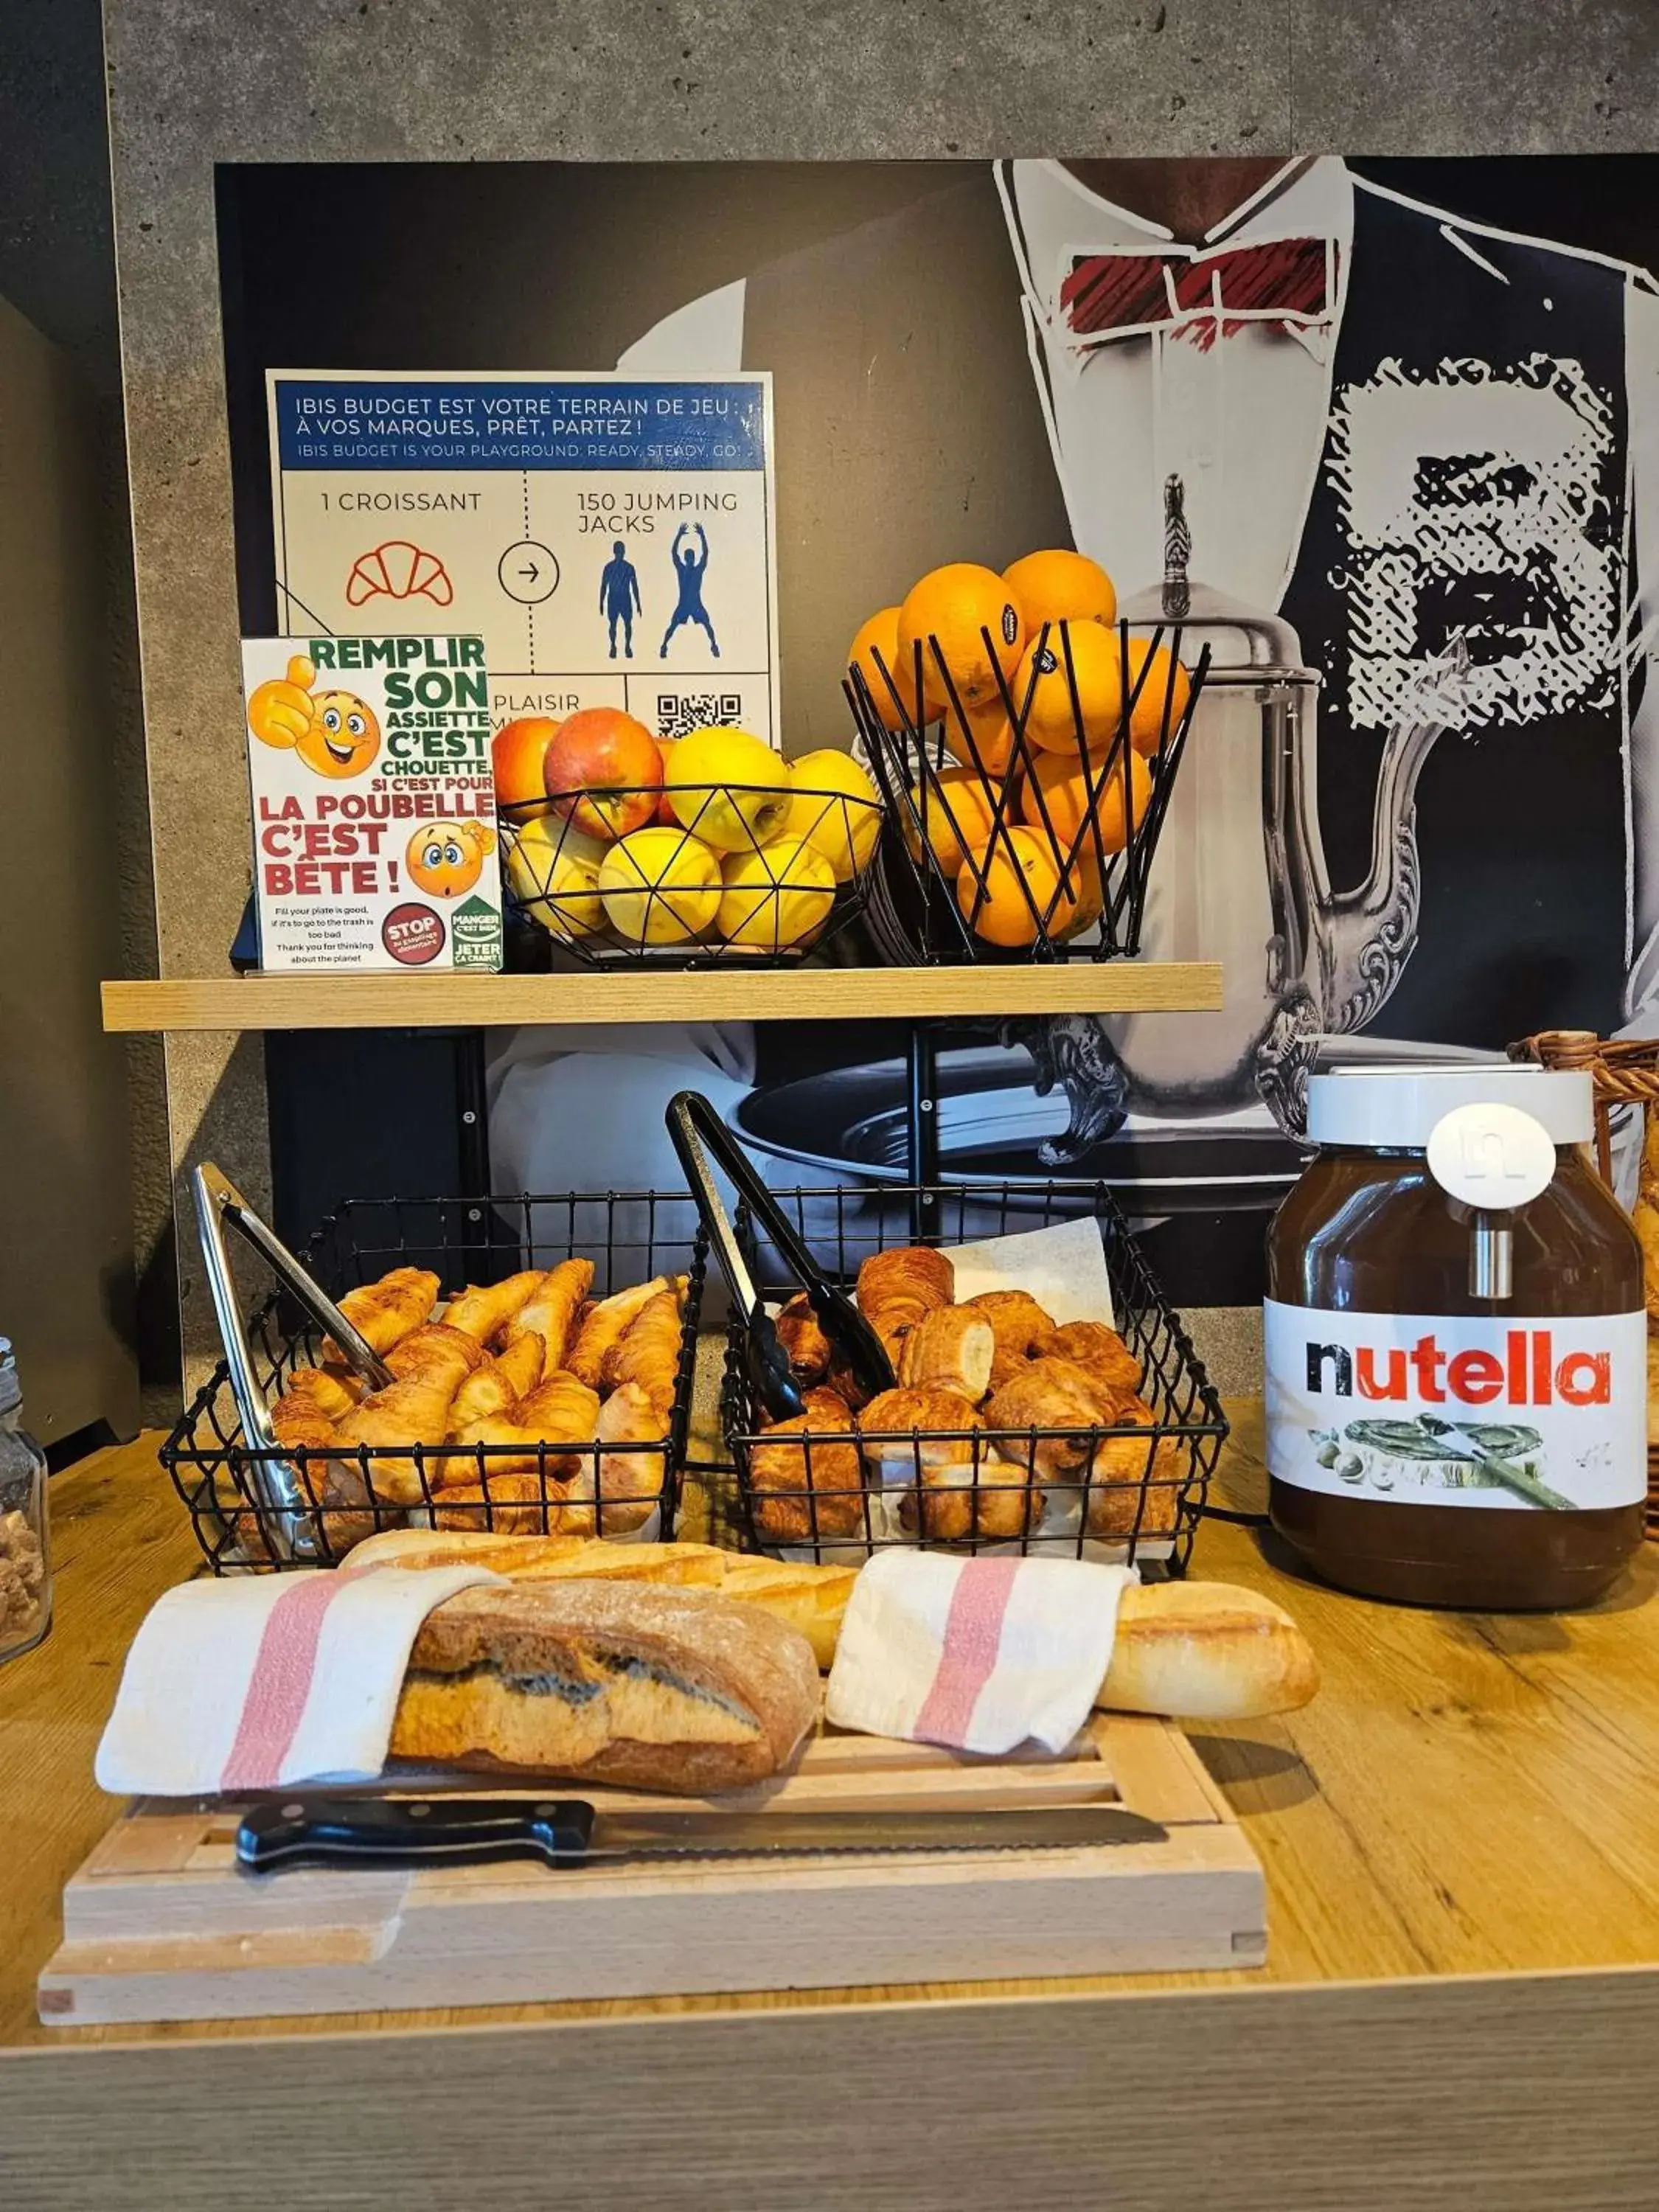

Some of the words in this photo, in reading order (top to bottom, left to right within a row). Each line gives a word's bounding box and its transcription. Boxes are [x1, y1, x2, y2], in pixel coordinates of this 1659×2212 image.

[296, 398, 336, 414] IBIS
[344, 398, 432, 414] BUDGET
[439, 398, 475, 414] EST
[481, 398, 552, 414] VOTRE
[558, 398, 648, 414] TERRAIN
[657, 399, 684, 414] DE
[691, 399, 728, 414] JEU
[296, 416, 311, 434] À
[317, 419, 361, 435] VOS
[369, 419, 480, 437] MARQUES,
[487, 417, 545, 436] PRÊT,
[298, 445, 328, 457] IBIS
[334, 445, 397, 457] BUDGET
[404, 445, 417, 457] IS
[421, 445, 465, 457] YOUR
[588, 445, 643, 458] READY,
[647, 445, 708, 458] STEADY,
[321, 493, 329, 511] 1
[338, 493, 481, 511] CROISSANT
[577, 493, 616, 511] 150
[624, 493, 737, 511] JUMPING
[578, 515, 655, 533] JACKS
[309, 638, 485, 669] REMPLIR
[383, 671, 488, 709] SON
[494, 695, 580, 711] PLAISIR
[386, 711, 490, 728] ASSIETTE
[387, 729, 490, 759] C'EST
[380, 759, 493, 776] CHOUETTE,
[372, 778, 387, 791] SI
[392, 778, 440, 791] C'EST
[445, 777, 493, 790] POUR
[260, 796, 305, 821] LA
[316, 793, 497, 820] POUBELLE
[261, 822, 389, 858] C'EST
[290, 908, 310, 917] your
[311, 906, 333, 916] plate
[335, 906, 343, 914] is
[327, 918, 341, 926] the
[343, 918, 366, 926] trash
[388, 917, 436, 940] STOP
[324, 931, 341, 939] bad
[276, 943, 305, 952] Thank
[305, 945, 322, 953] you
[324, 942, 335, 950] for
[337, 942, 374, 952] thinking
[455, 943, 501, 955] JETER
[291, 955, 316, 963] about
[333, 954, 361, 964] planet
[1305, 1329, 1612, 1406] nutella
